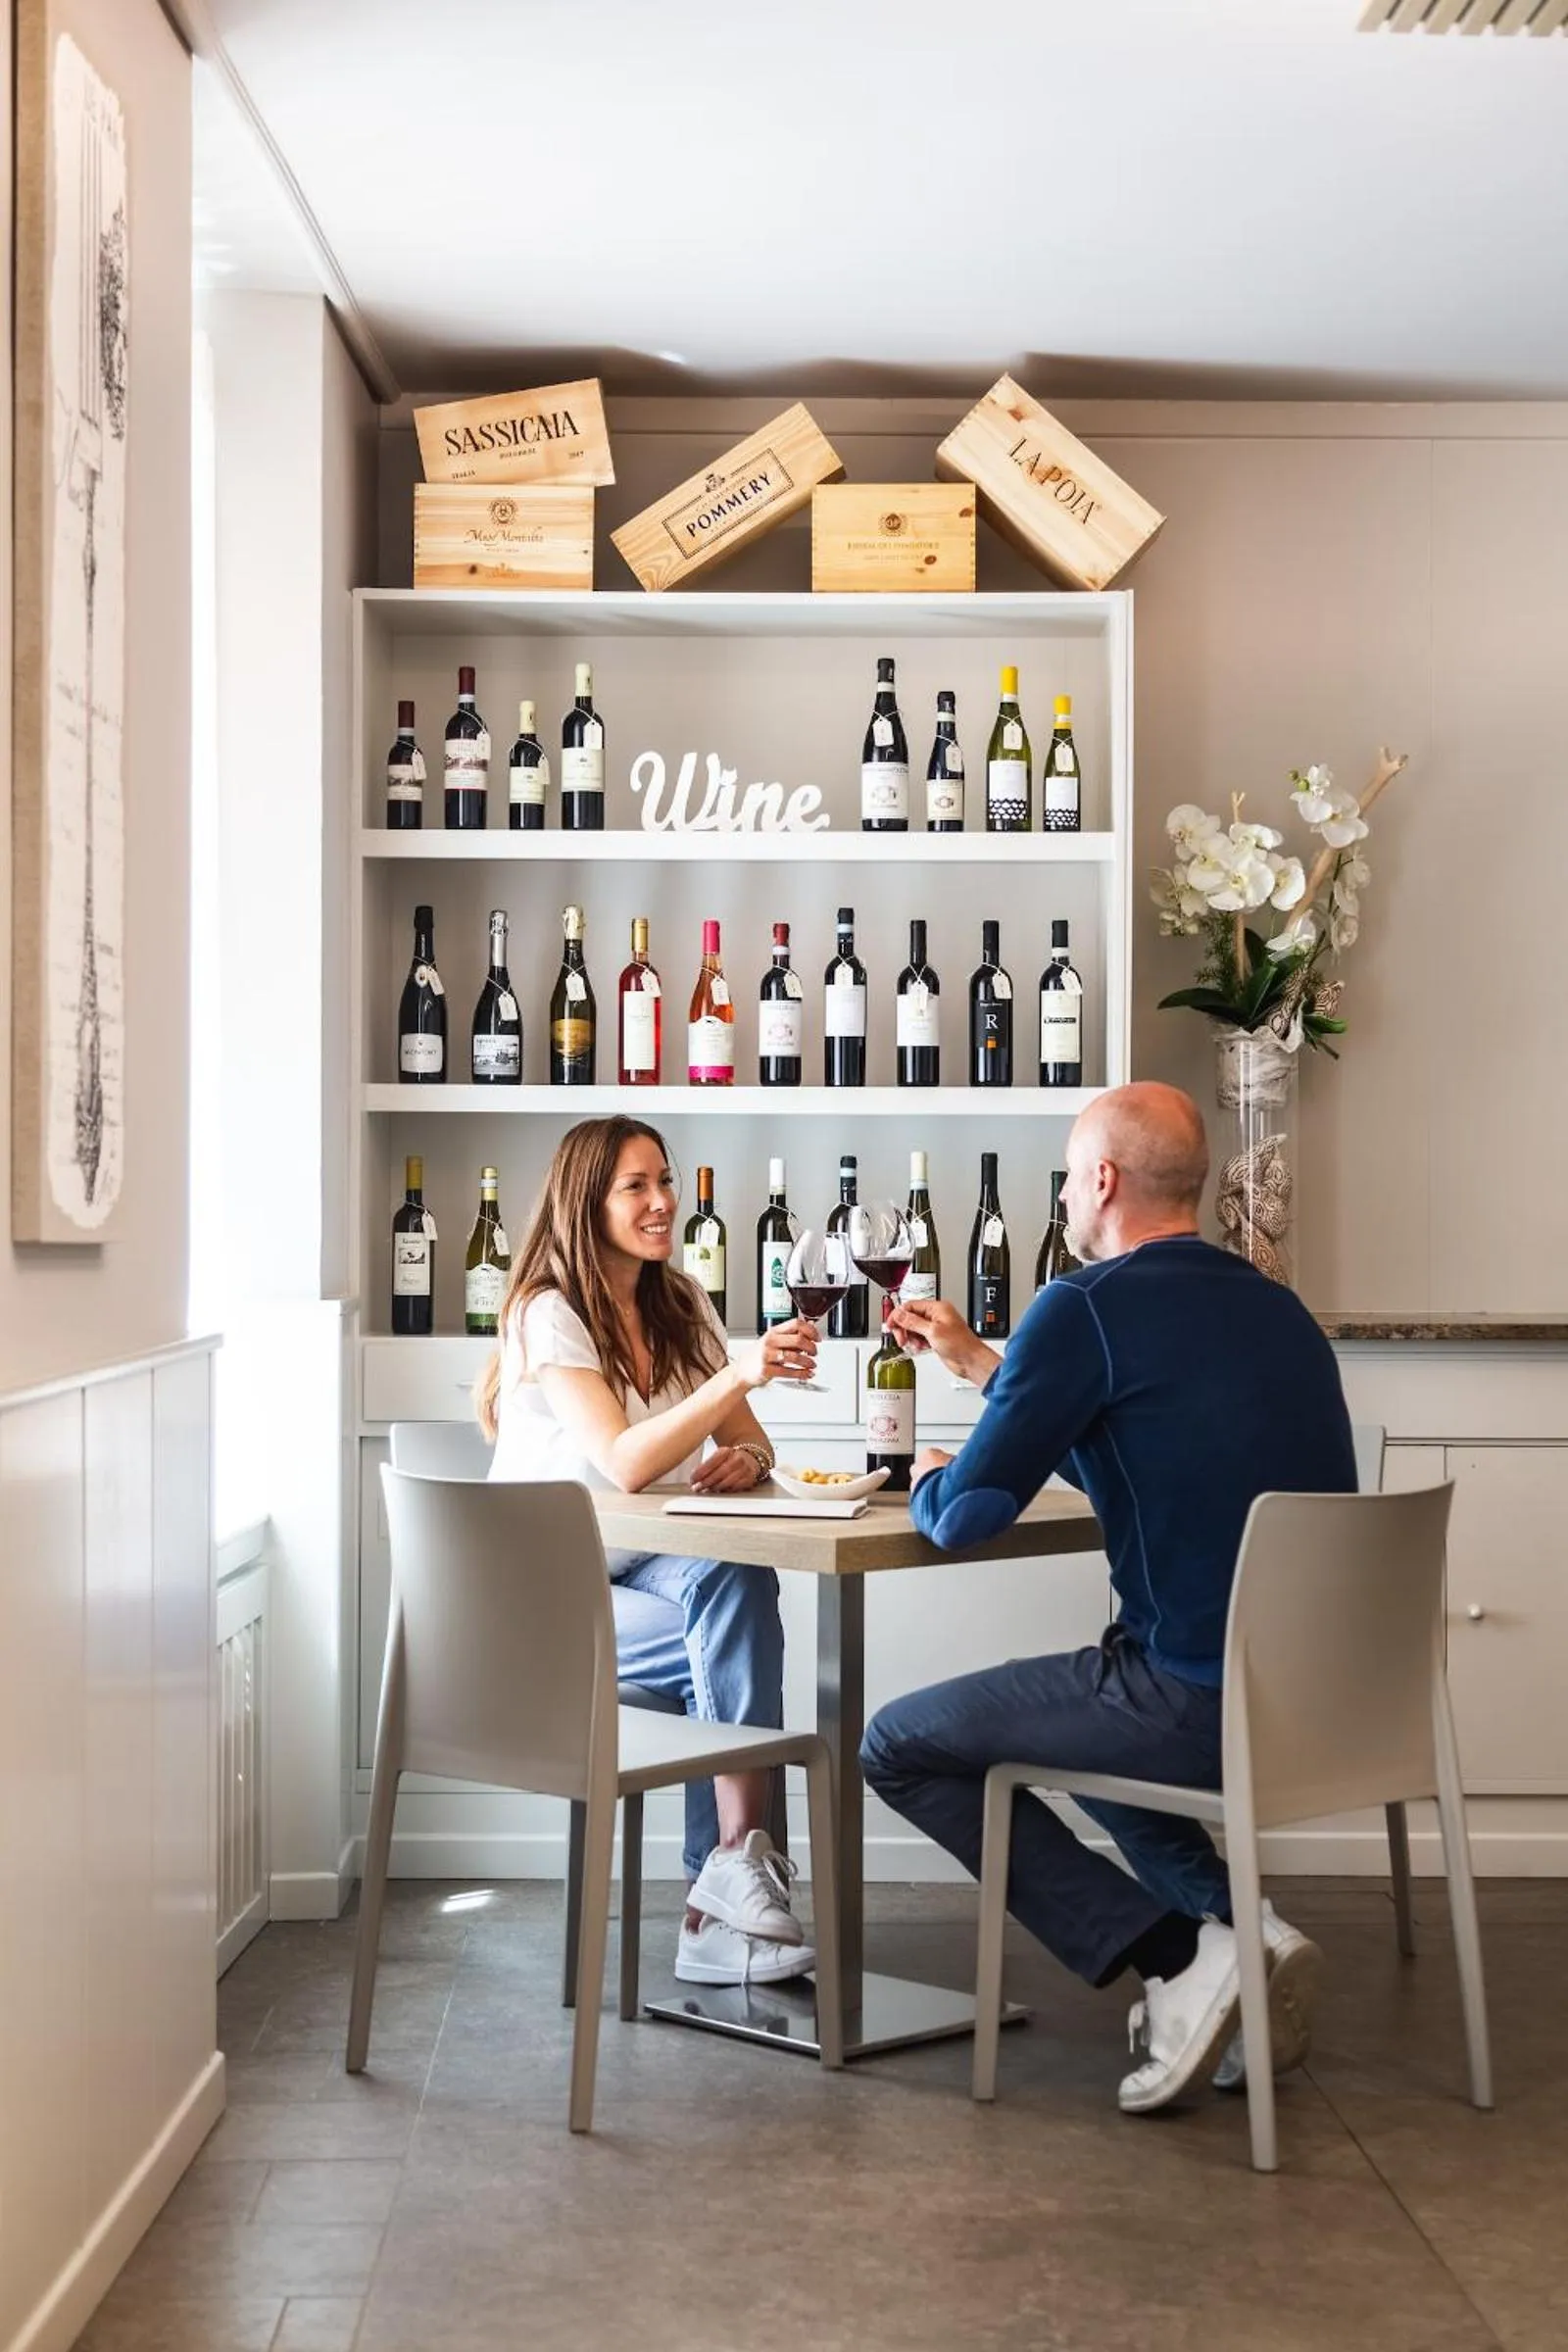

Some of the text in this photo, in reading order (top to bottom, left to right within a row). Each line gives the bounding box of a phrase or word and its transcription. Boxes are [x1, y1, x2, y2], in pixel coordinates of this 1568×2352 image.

[444, 410, 580, 456] SASSICAIA
[686, 471, 770, 538] POMMERY
[1007, 438, 1095, 525] LA POIA
[630, 751, 831, 832] Wine
[984, 1013, 999, 1029] R
[985, 1286, 997, 1302] F
